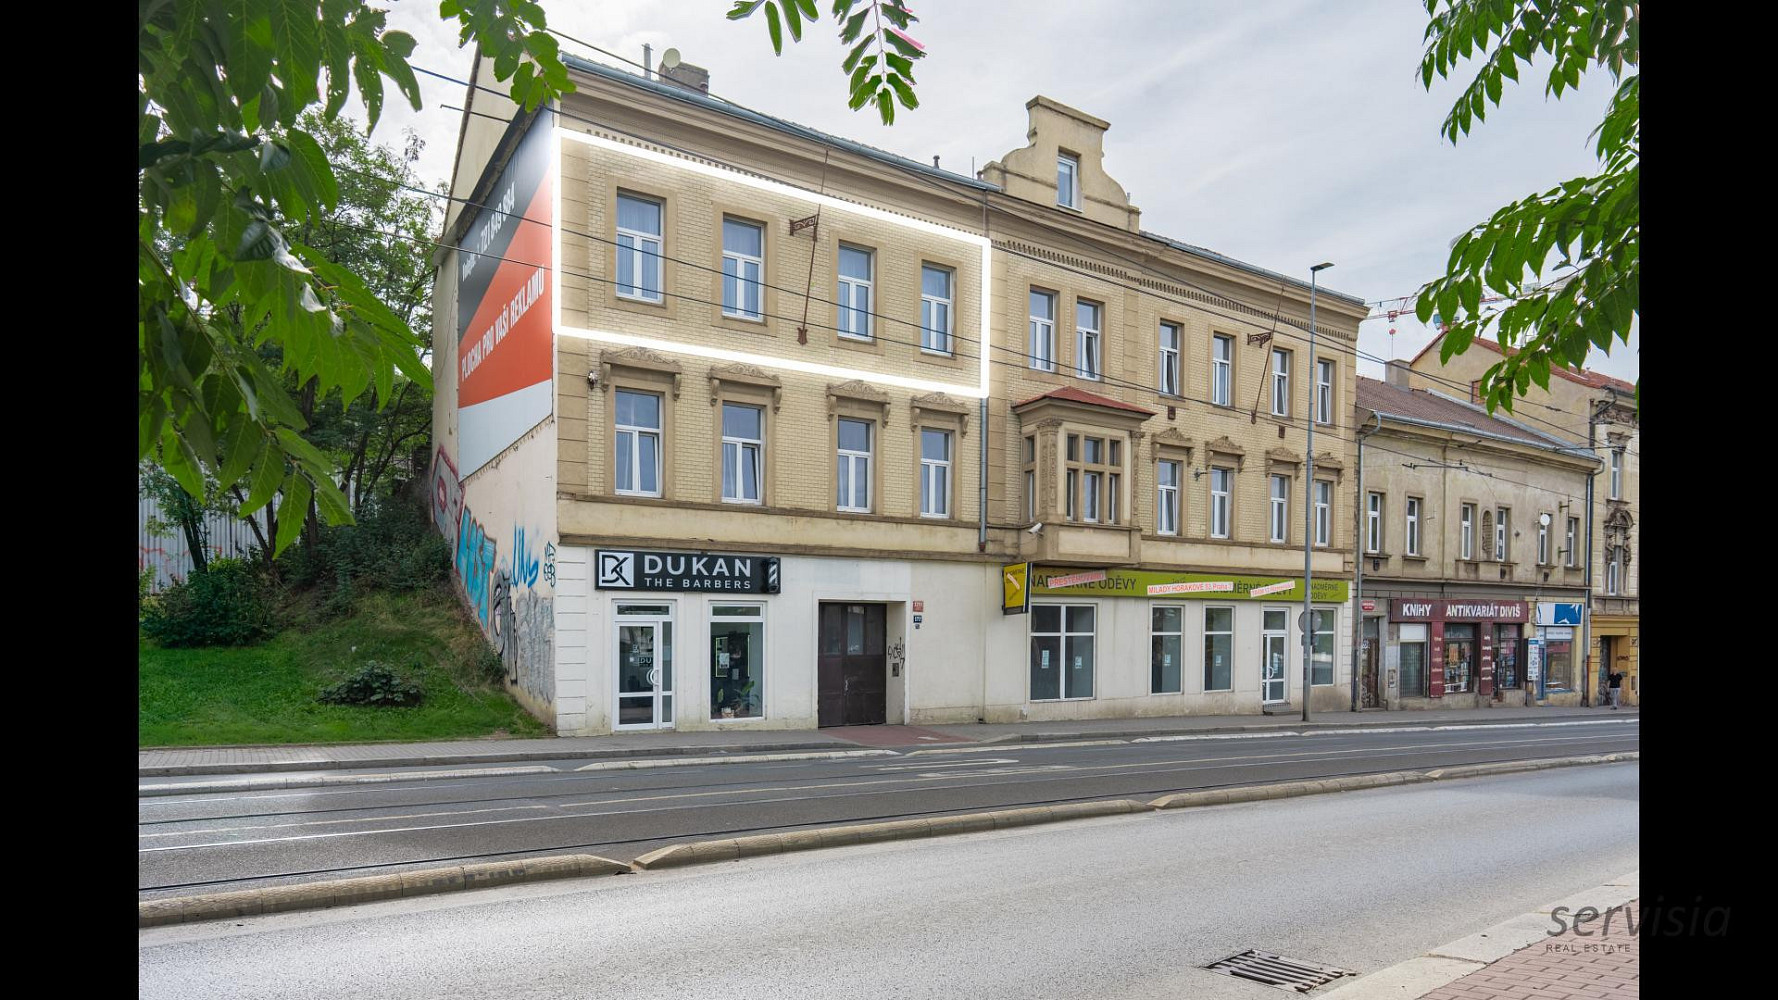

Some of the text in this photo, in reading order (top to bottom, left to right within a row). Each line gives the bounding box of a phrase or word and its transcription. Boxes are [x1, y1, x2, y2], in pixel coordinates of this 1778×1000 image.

[461, 340, 482, 382] PLOCHA
[482, 325, 494, 360] PRO
[510, 263, 545, 328] REKLAMU
[643, 554, 751, 577] DUKAN
[644, 577, 751, 589] THE BARBERS
[1098, 575, 1137, 590] ODĚVY
[1402, 603, 1521, 617] KNIHY ANTIKVARIÁT DIVIŠ
